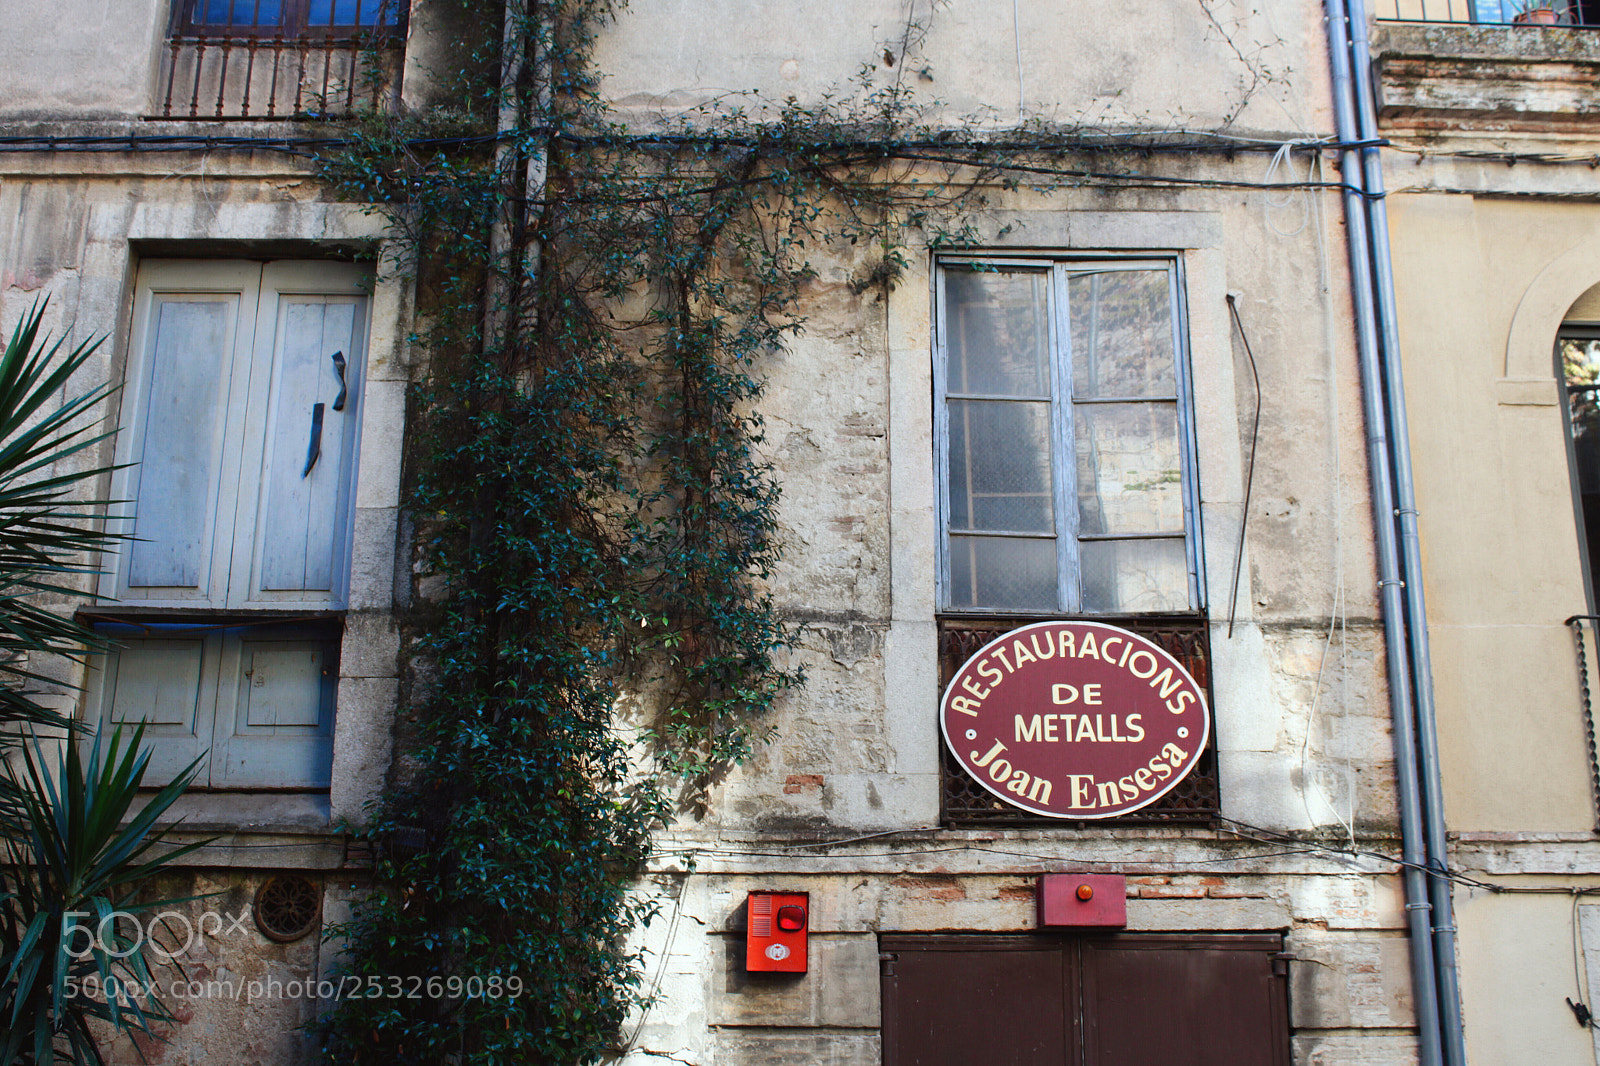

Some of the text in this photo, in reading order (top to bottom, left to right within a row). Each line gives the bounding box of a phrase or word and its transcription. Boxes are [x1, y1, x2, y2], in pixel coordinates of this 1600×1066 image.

[950, 630, 1196, 718] RESTAURACIONS
[1051, 683, 1103, 705] DE
[1014, 713, 1146, 743] METALLS
[969, 737, 1189, 809] Joan Ensesa
